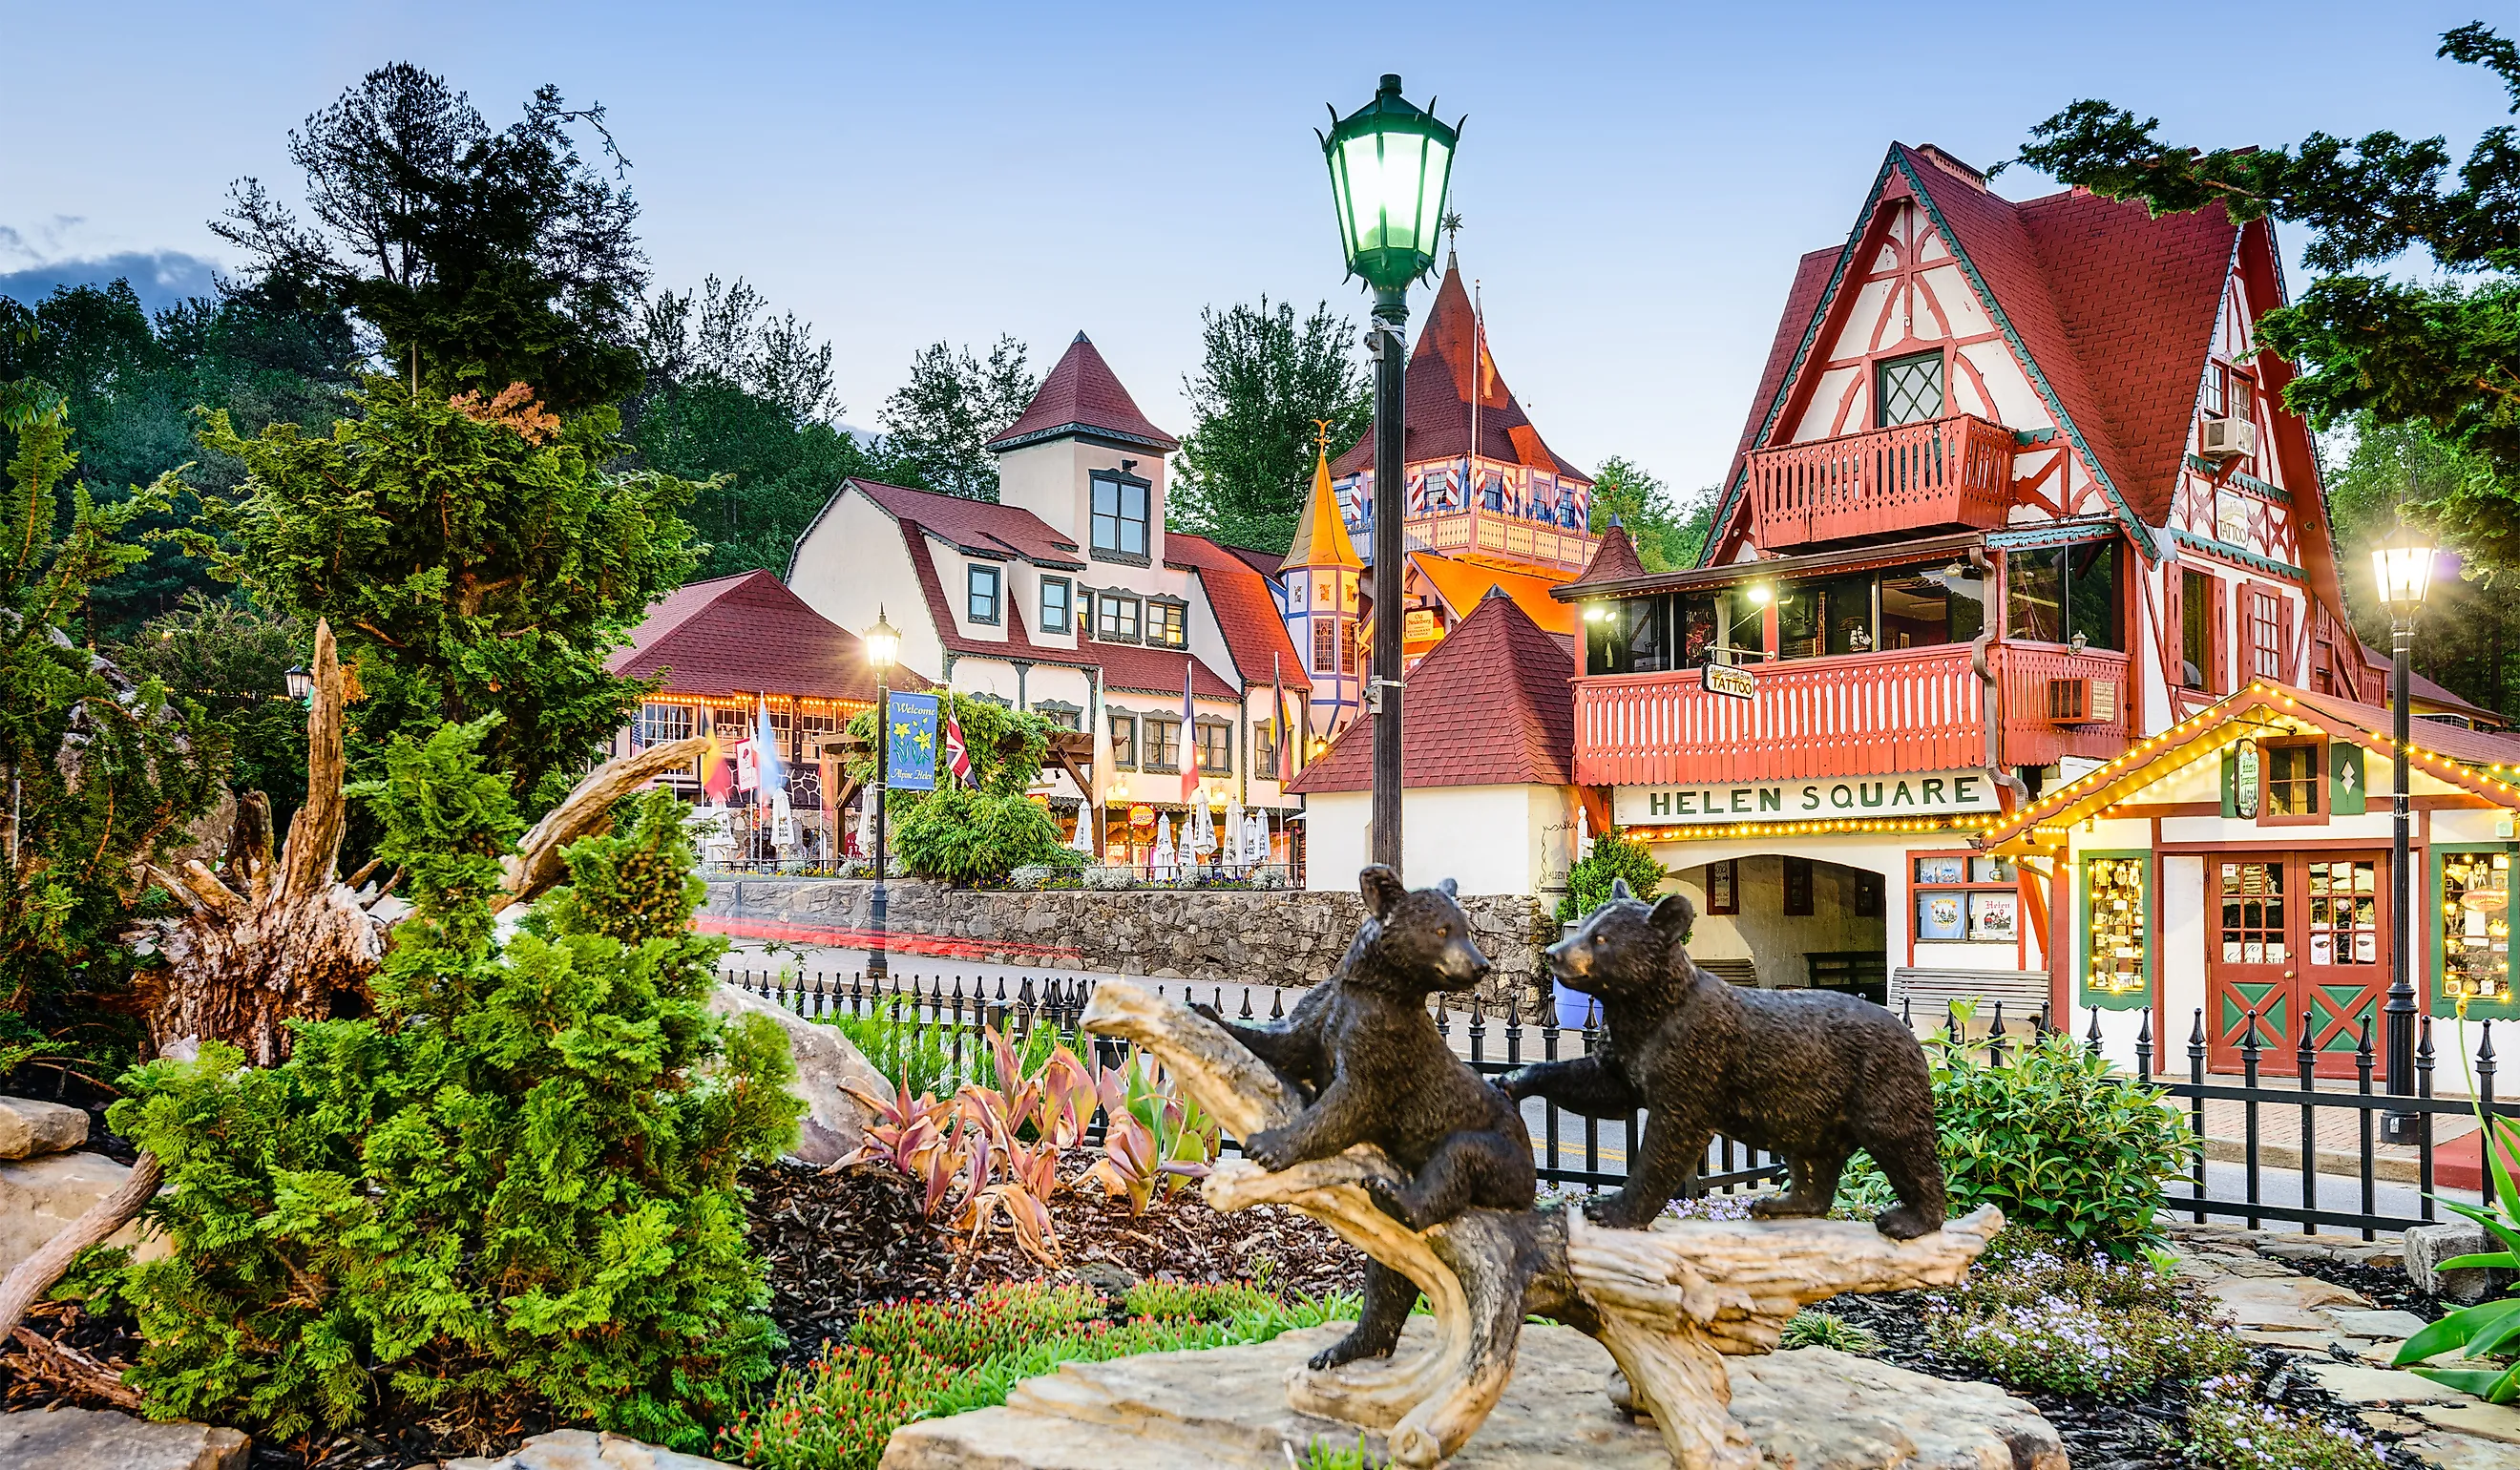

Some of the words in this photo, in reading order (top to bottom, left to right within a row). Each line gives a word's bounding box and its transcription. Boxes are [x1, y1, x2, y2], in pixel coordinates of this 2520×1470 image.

[2218, 519, 2246, 543] TATTOO
[1712, 675, 1753, 695] TATTOO
[892, 702, 935, 716] Welcome
[891, 767, 914, 782] Alpine
[914, 769, 933, 780] Helen
[1649, 788, 1781, 816] HELEN
[1801, 776, 1981, 810] SQUARE
[1984, 900, 2010, 910] Helen
